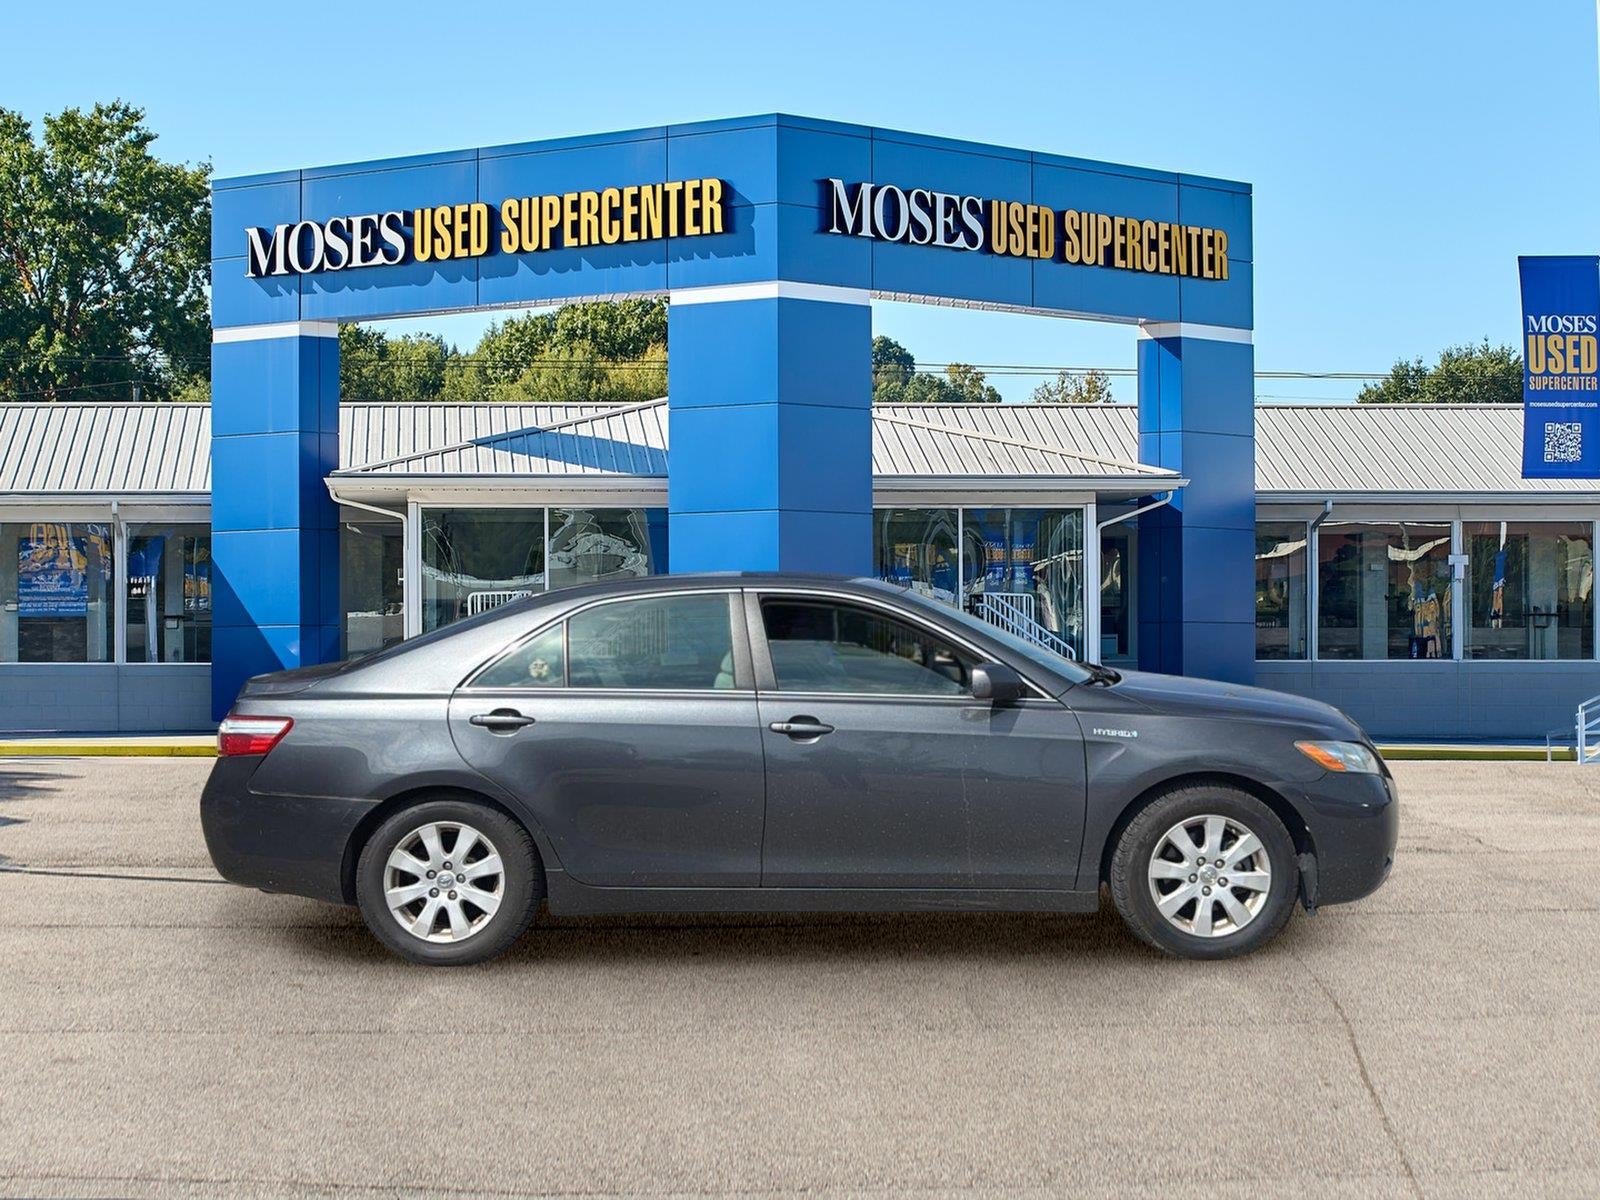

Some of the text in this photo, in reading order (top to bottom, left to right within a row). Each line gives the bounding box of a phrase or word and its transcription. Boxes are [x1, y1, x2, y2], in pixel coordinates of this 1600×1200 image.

[244, 177, 724, 278] MOSES USED SUPERCENTER
[828, 178, 1230, 280] MOSES USED SUPERCENTER
[1527, 314, 1597, 334] MOSES
[1528, 334, 1598, 374] USED
[1529, 376, 1598, 391] SUPERCENTER
[1093, 727, 1131, 738] HYBRID
